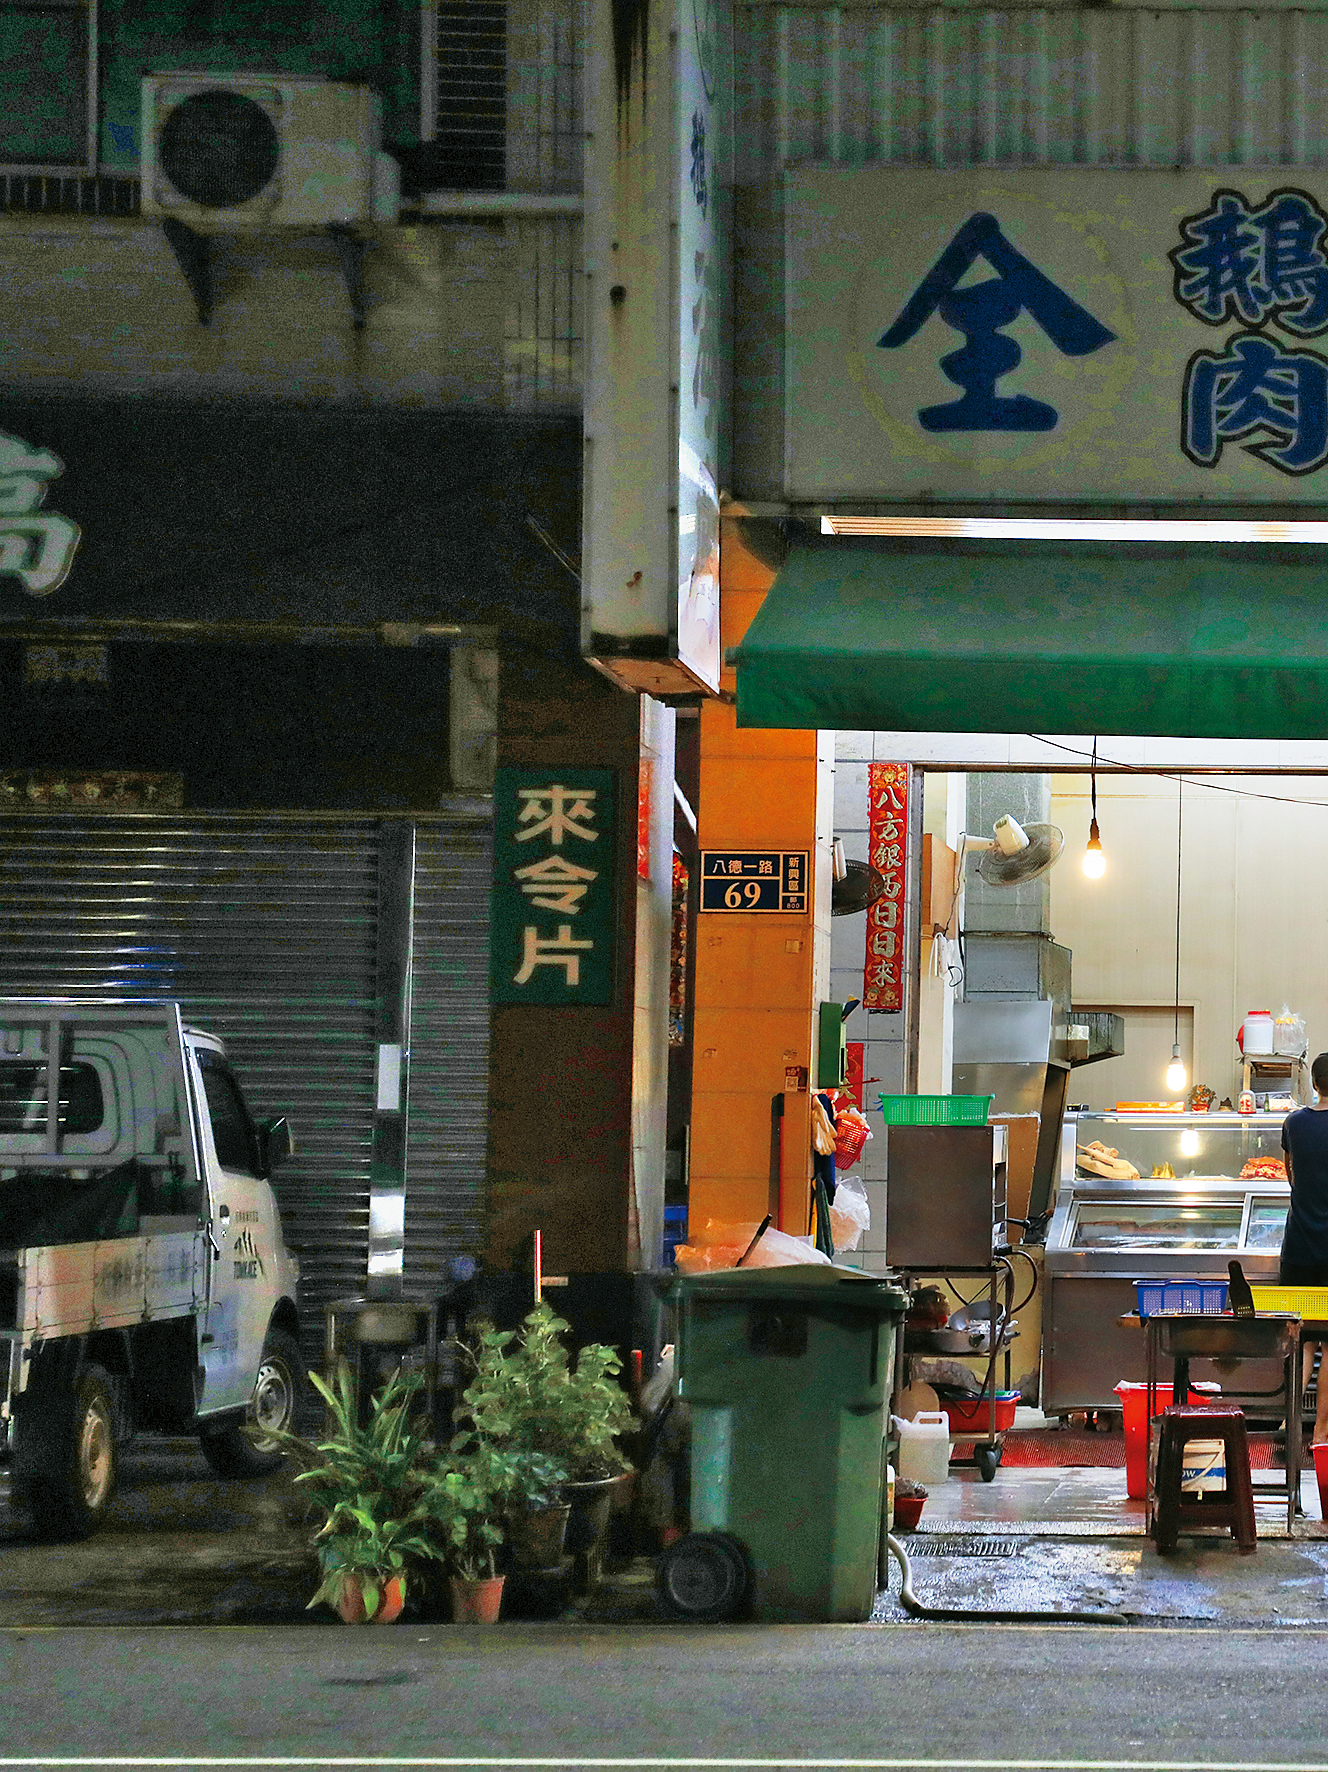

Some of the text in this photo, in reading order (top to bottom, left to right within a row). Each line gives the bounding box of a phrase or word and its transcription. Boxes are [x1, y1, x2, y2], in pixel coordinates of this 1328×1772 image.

[875, 211, 1119, 434] 全
[513, 784, 600, 986] 來令片
[712, 859, 774, 874] 八德一路
[724, 881, 762, 909] 69
